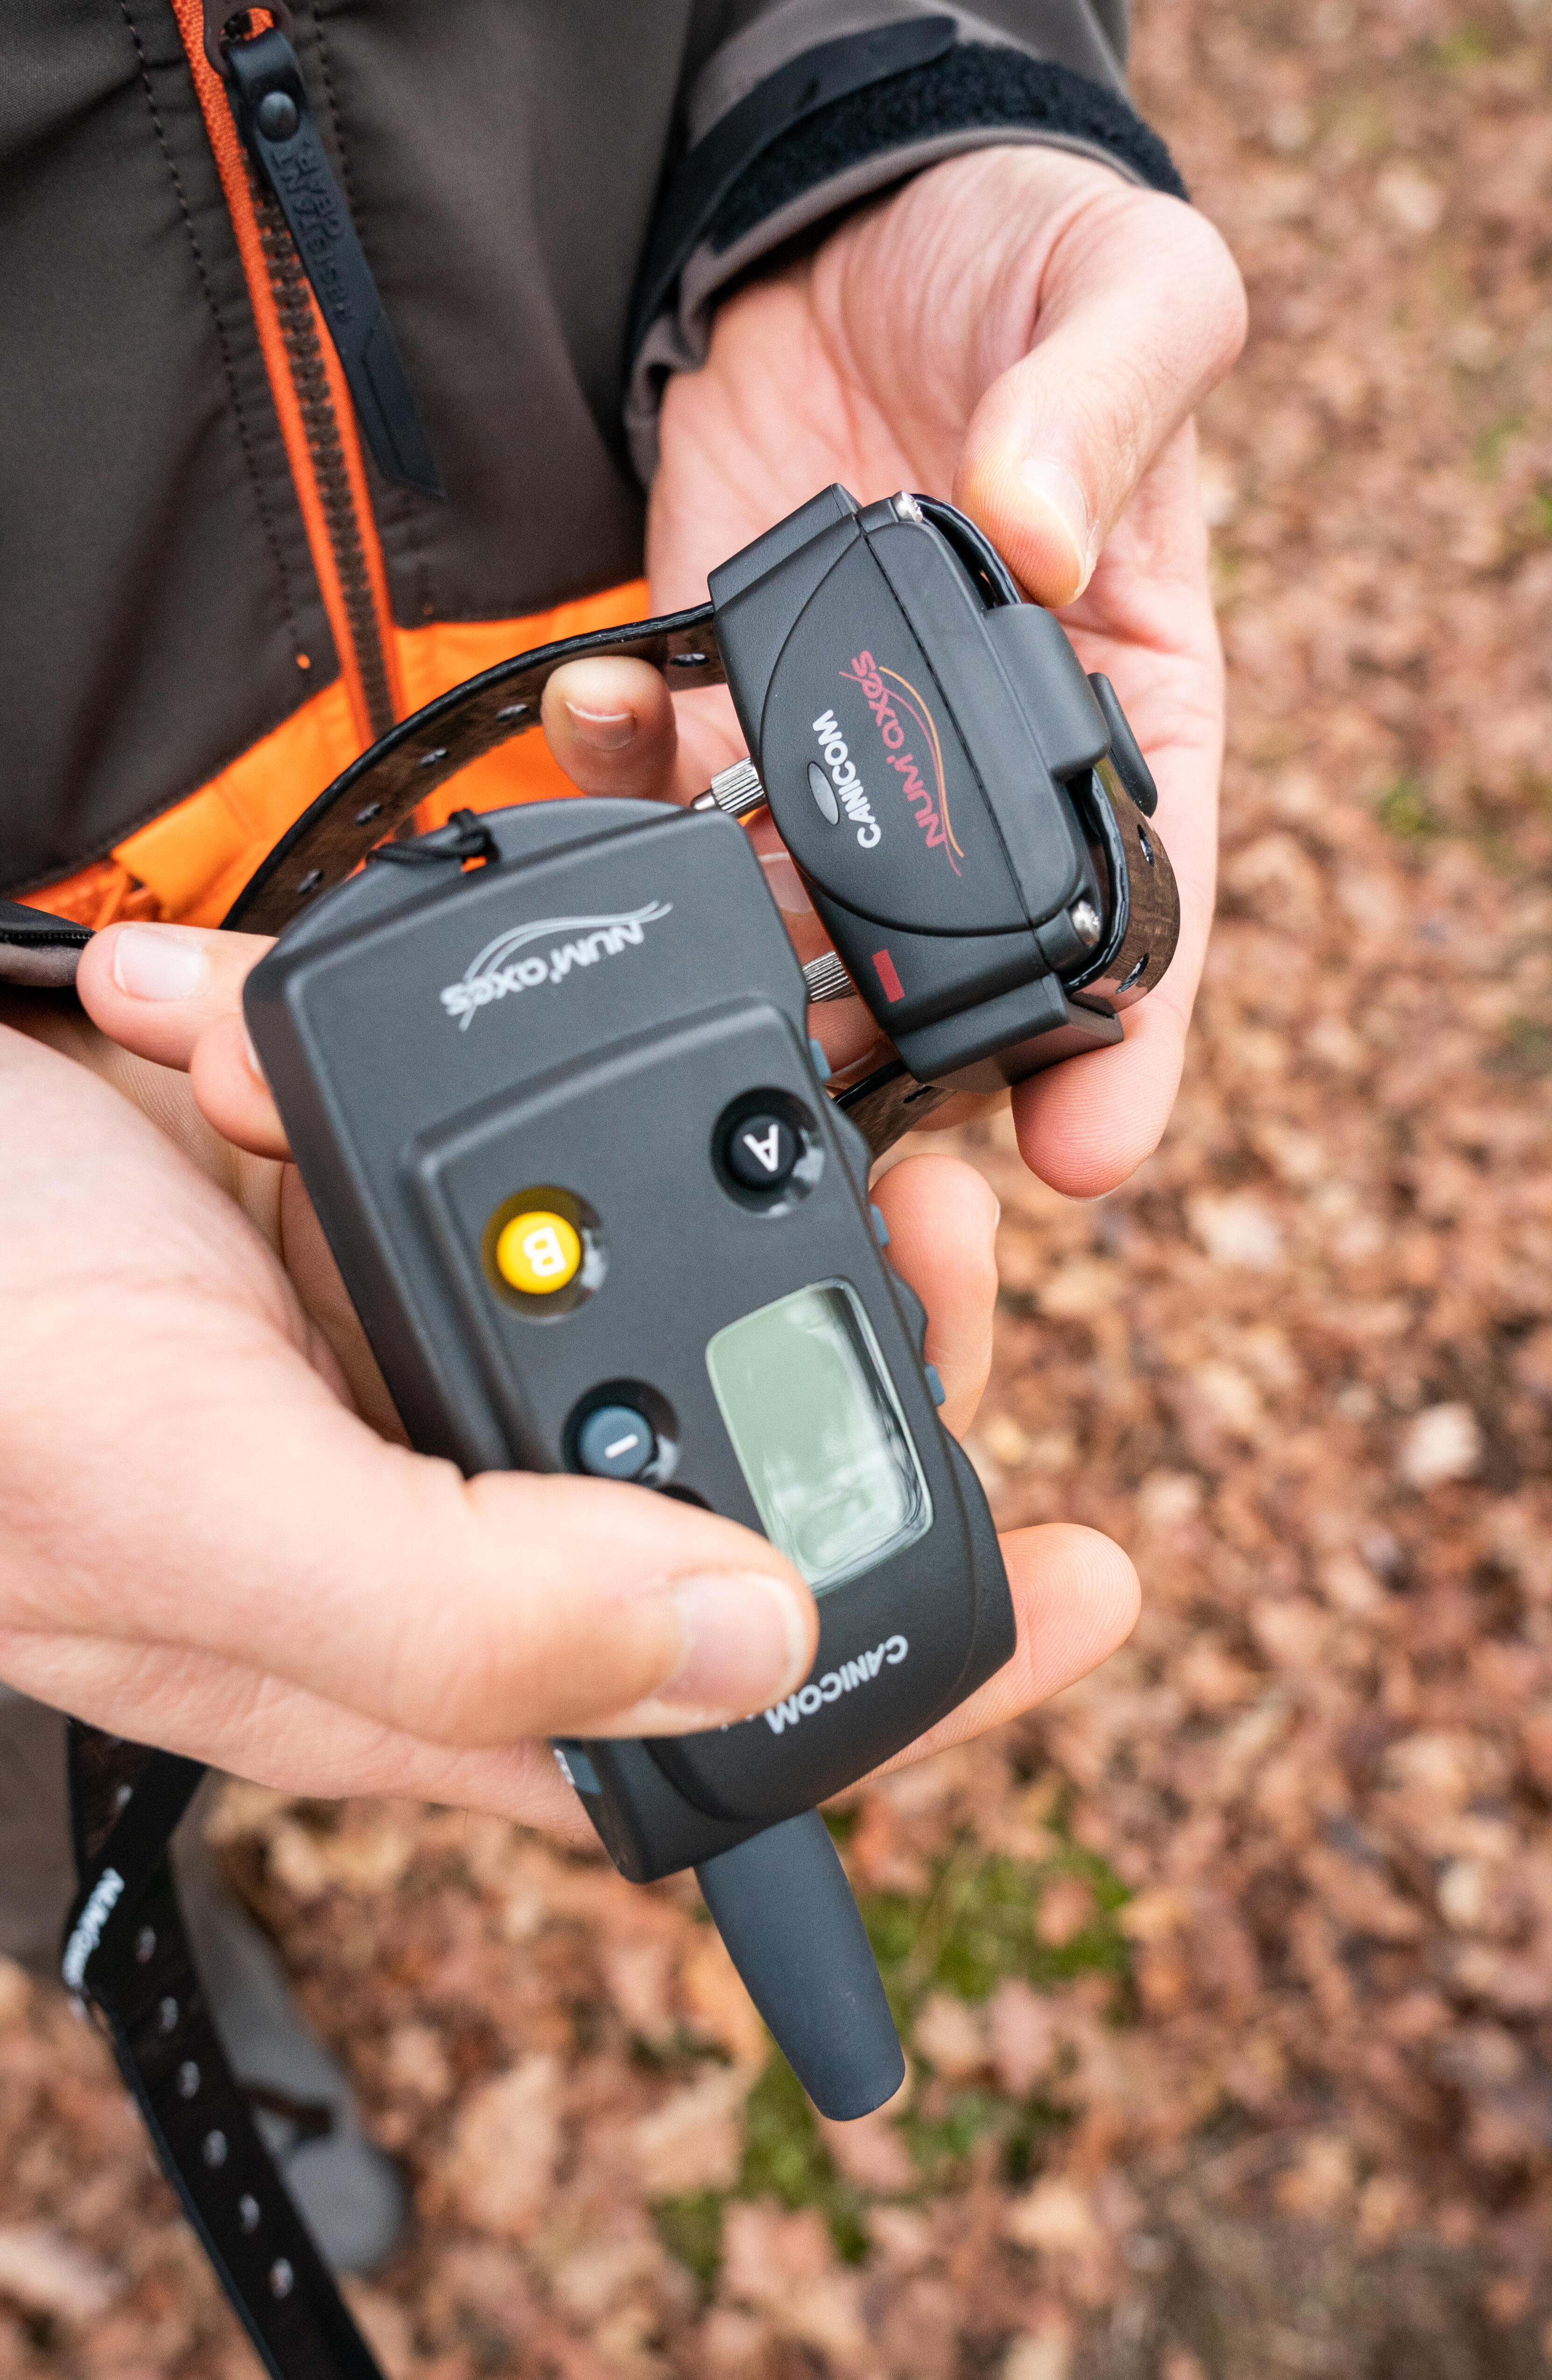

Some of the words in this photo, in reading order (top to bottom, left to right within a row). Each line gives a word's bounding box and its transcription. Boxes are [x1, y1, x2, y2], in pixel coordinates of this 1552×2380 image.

[812, 709, 882, 849] CANICOM
[743, 1123, 779, 1172] A
[522, 1226, 567, 1277] B
[764, 1634, 909, 1734] CANICOM
